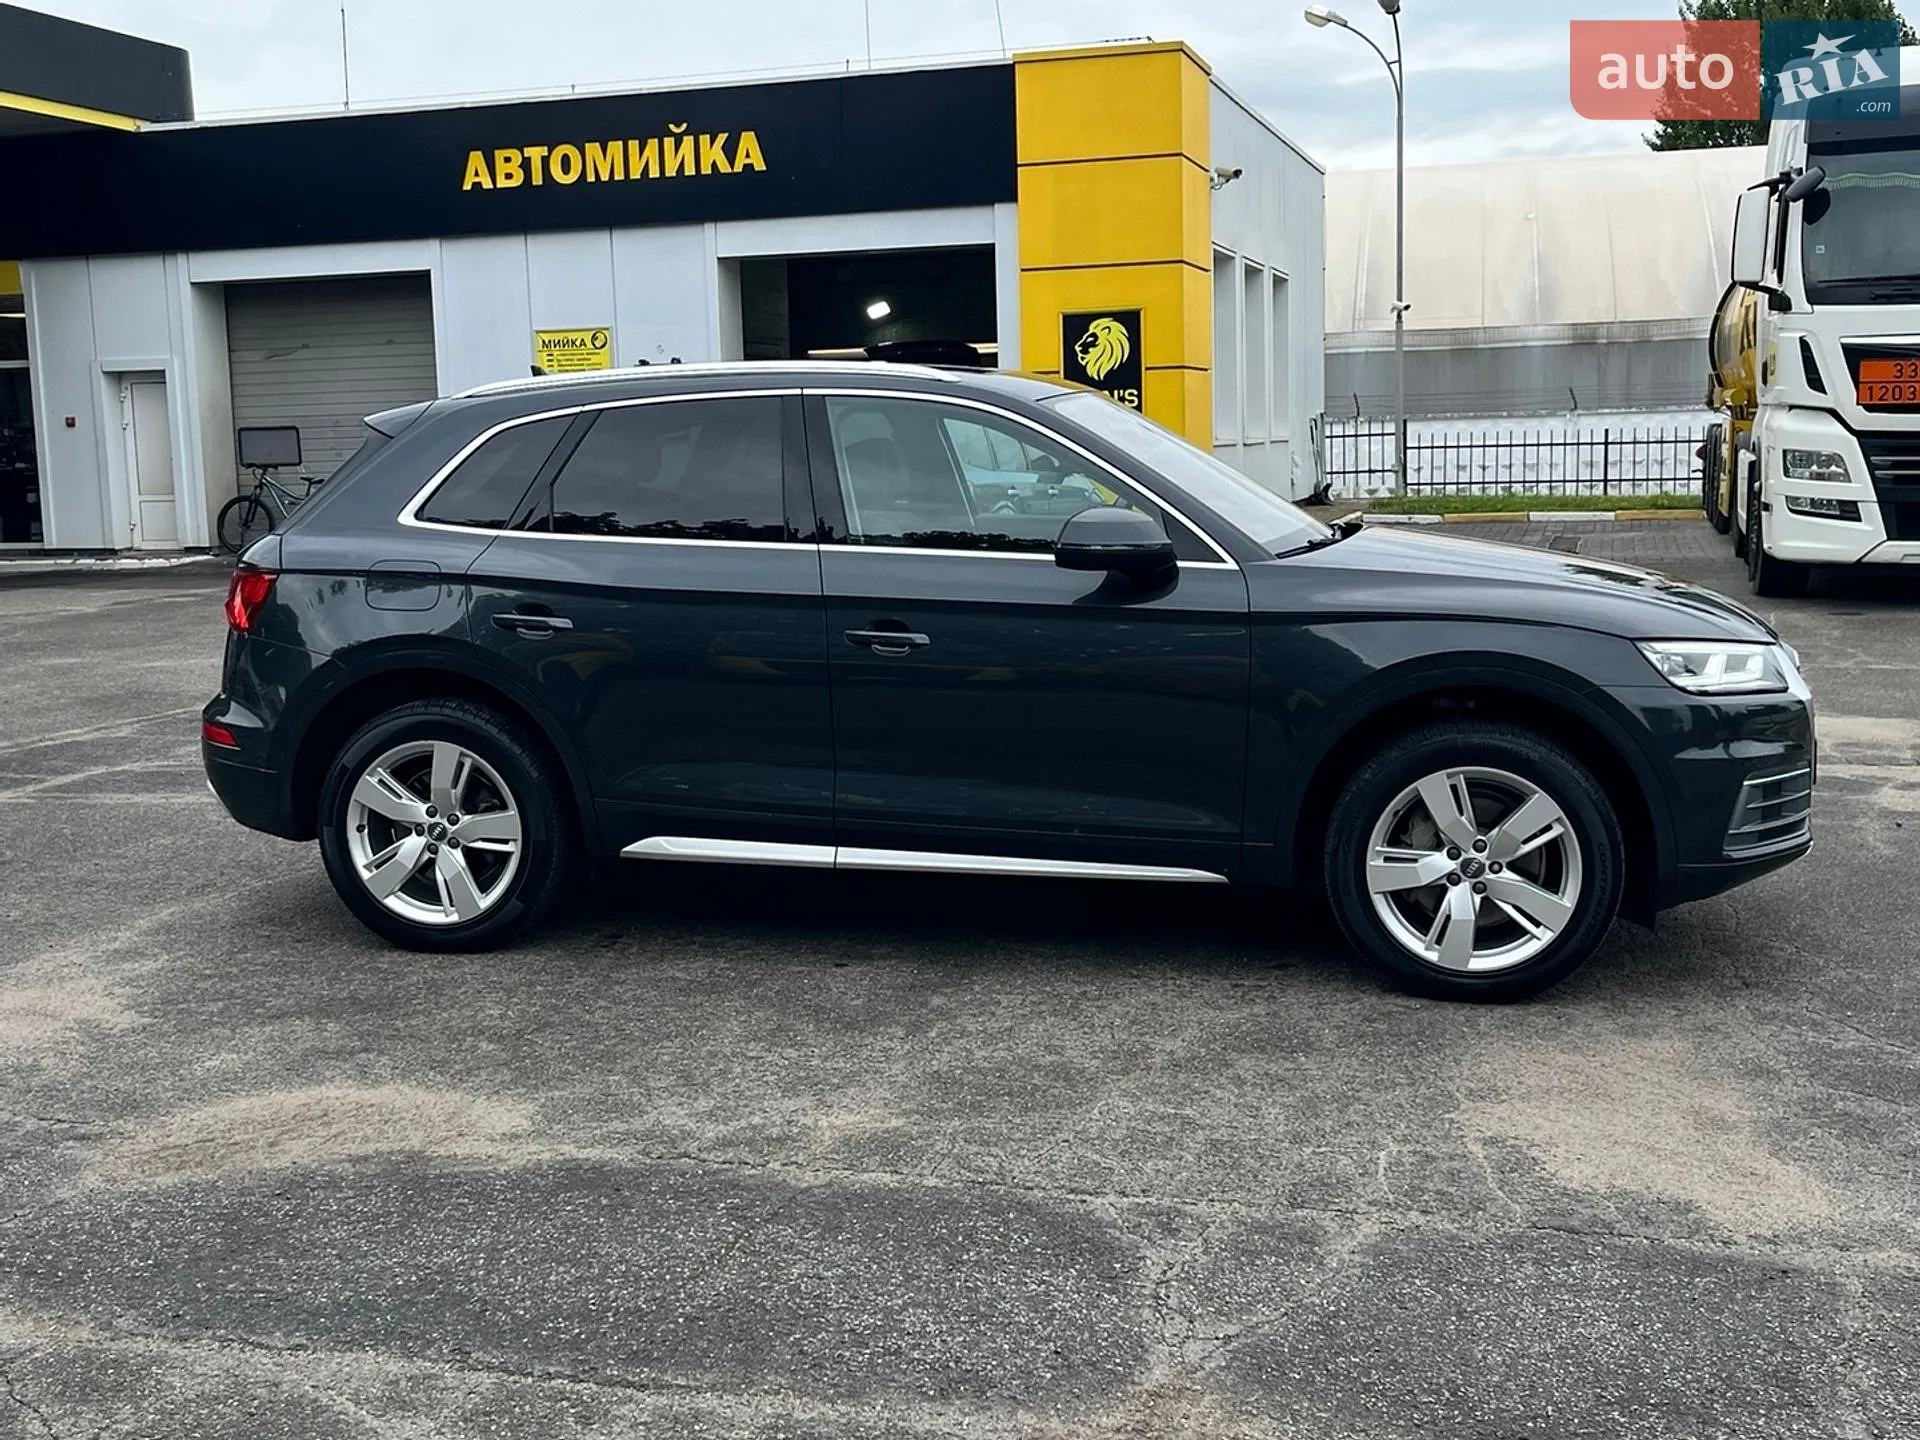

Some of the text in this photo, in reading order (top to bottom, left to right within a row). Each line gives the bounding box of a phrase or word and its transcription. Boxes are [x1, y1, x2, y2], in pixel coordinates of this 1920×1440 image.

[462, 122, 768, 190] АВТОМИЙКА
[541, 336, 588, 350] МИЙКА
[1893, 362, 1919, 379] 33
[1867, 385, 1917, 401] 1203
